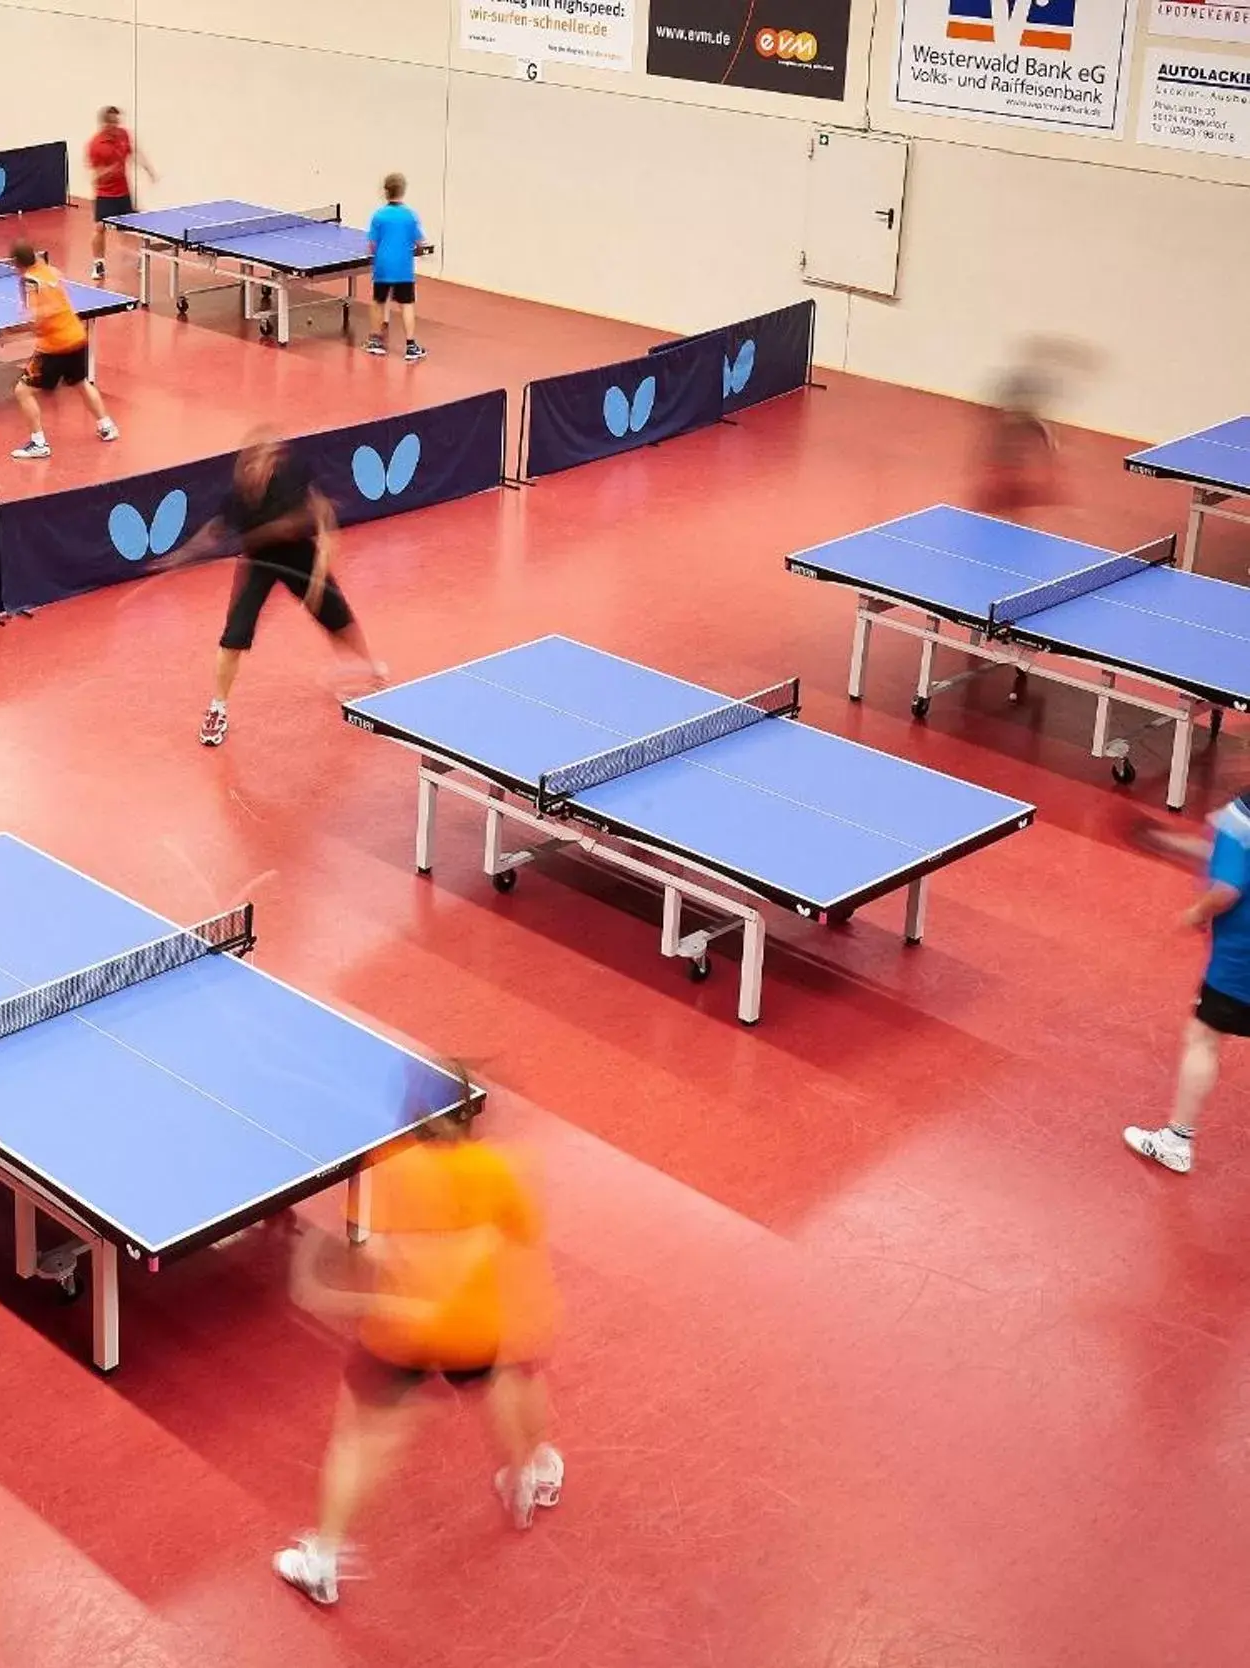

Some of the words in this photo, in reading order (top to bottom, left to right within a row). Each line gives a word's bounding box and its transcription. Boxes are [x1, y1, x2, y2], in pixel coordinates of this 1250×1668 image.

[554, 0, 625, 17] Highspeed:
[470, 6, 608, 37] wir-surfen-schneller.de
[655, 25, 731, 46] www.evm.de
[760, 32, 814, 56] evm
[526, 63, 538, 80] G
[913, 45, 1019, 74] Westerwald
[1025, 57, 1073, 81] Bank
[1078, 65, 1106, 84] eG
[911, 66, 952, 84] Volks-
[957, 74, 987, 90] und
[990, 76, 1103, 104] Raiffeisenbank
